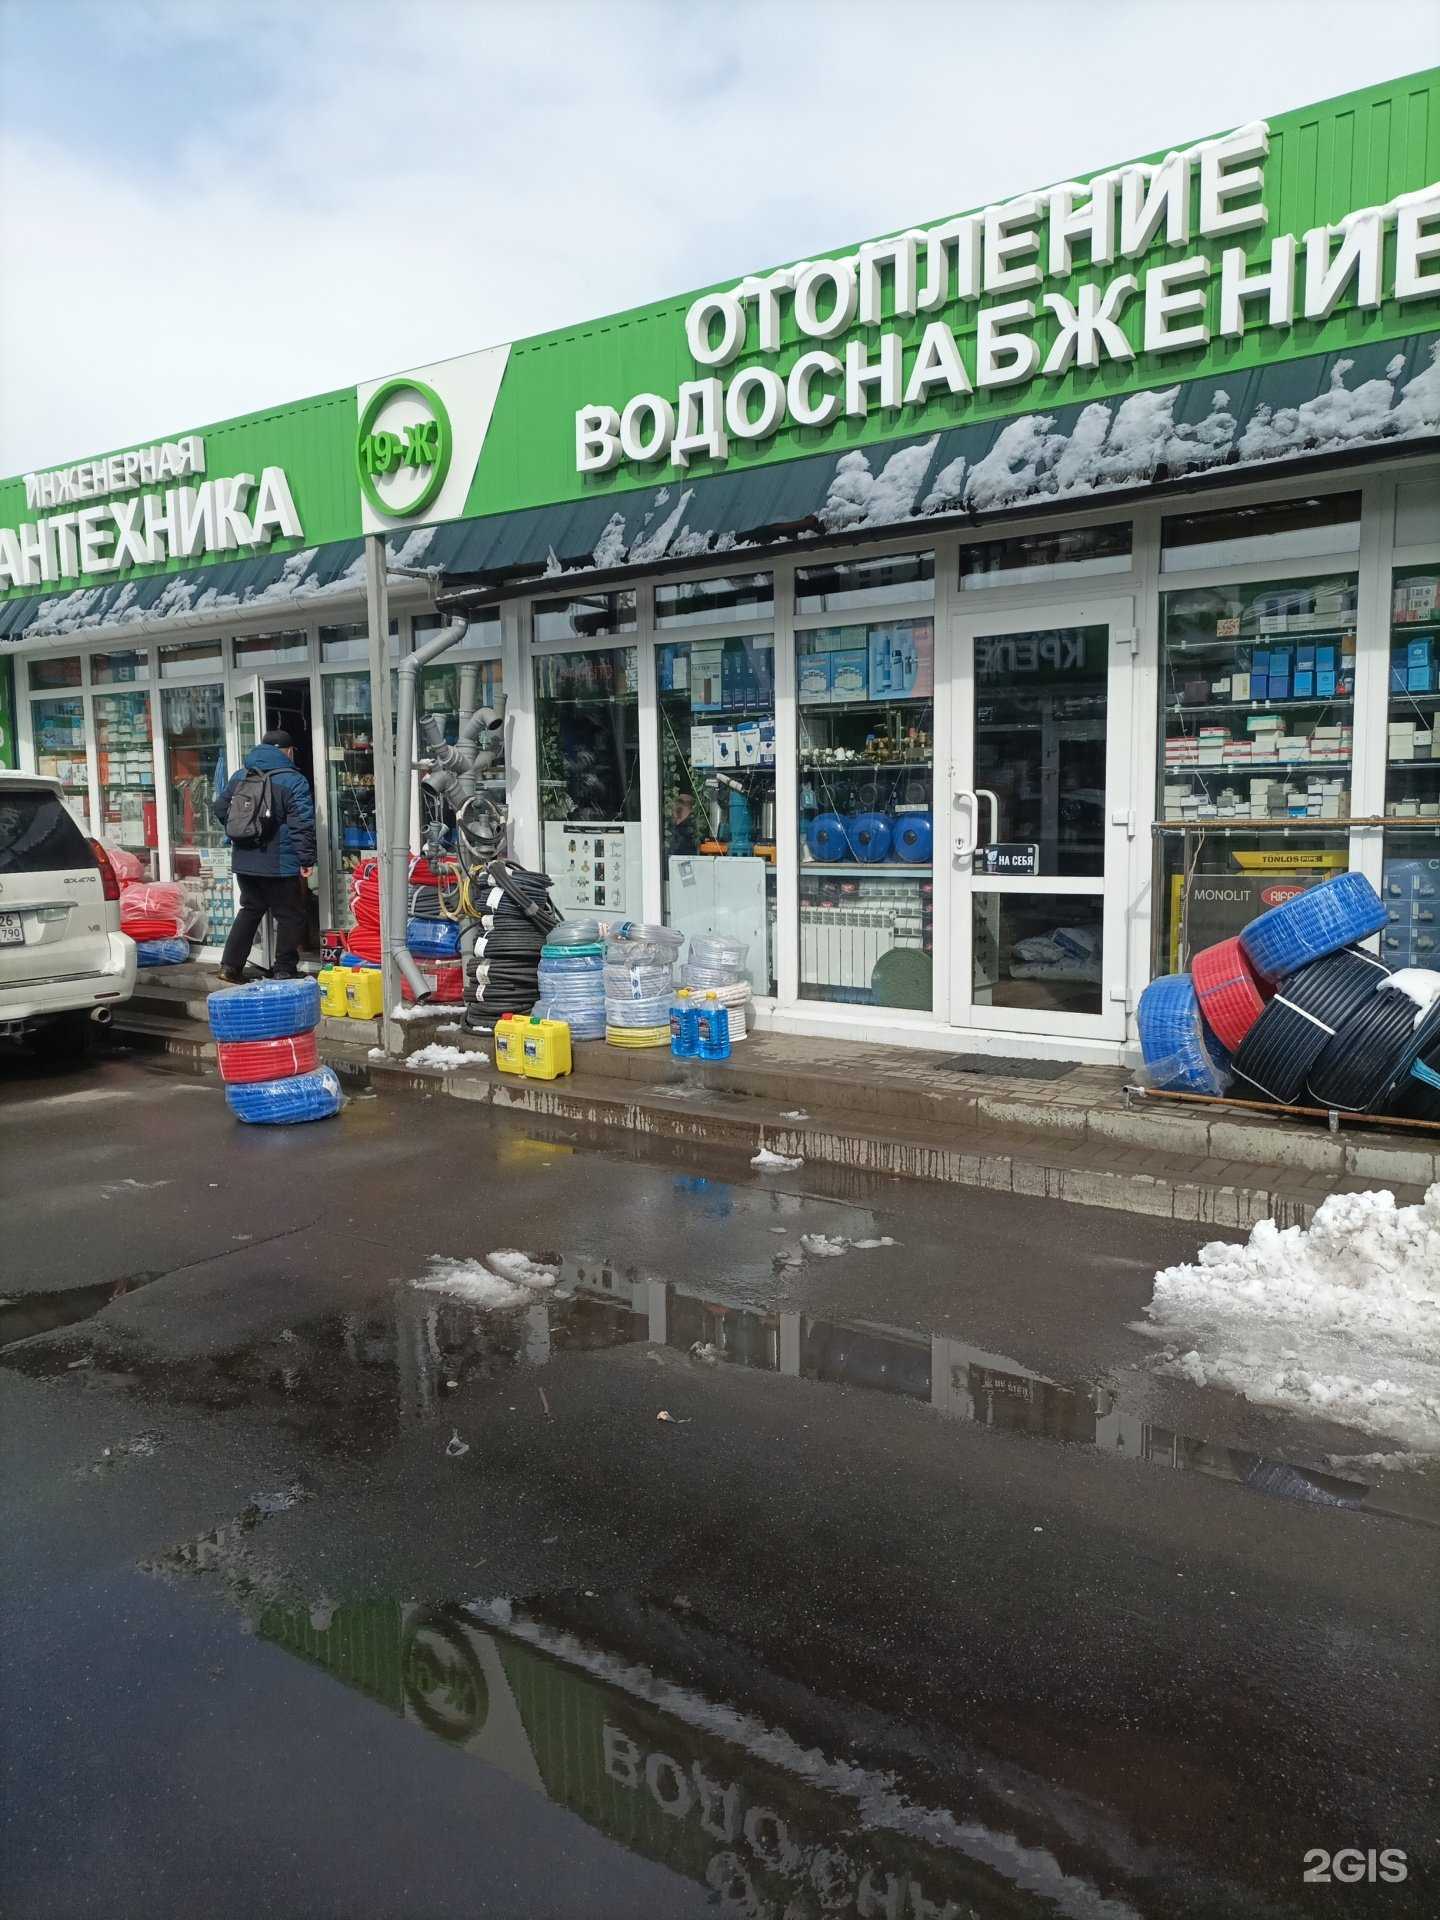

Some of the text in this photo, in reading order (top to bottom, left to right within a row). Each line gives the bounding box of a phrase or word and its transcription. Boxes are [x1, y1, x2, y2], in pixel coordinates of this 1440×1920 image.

[686, 125, 1269, 367] ОТОПЛЕНИЕ
[575, 194, 1440, 472] ВОДОСНАБЖЕНИЕ
[23, 436, 206, 510] ИНЖЕНЕРНАЯ
[361, 420, 438, 476] 19-Ж
[999, 855, 1033, 866] НА СЕБЯ
[1194, 889, 1251, 901] MONOLIT
[1, 928, 20, 938] 790
